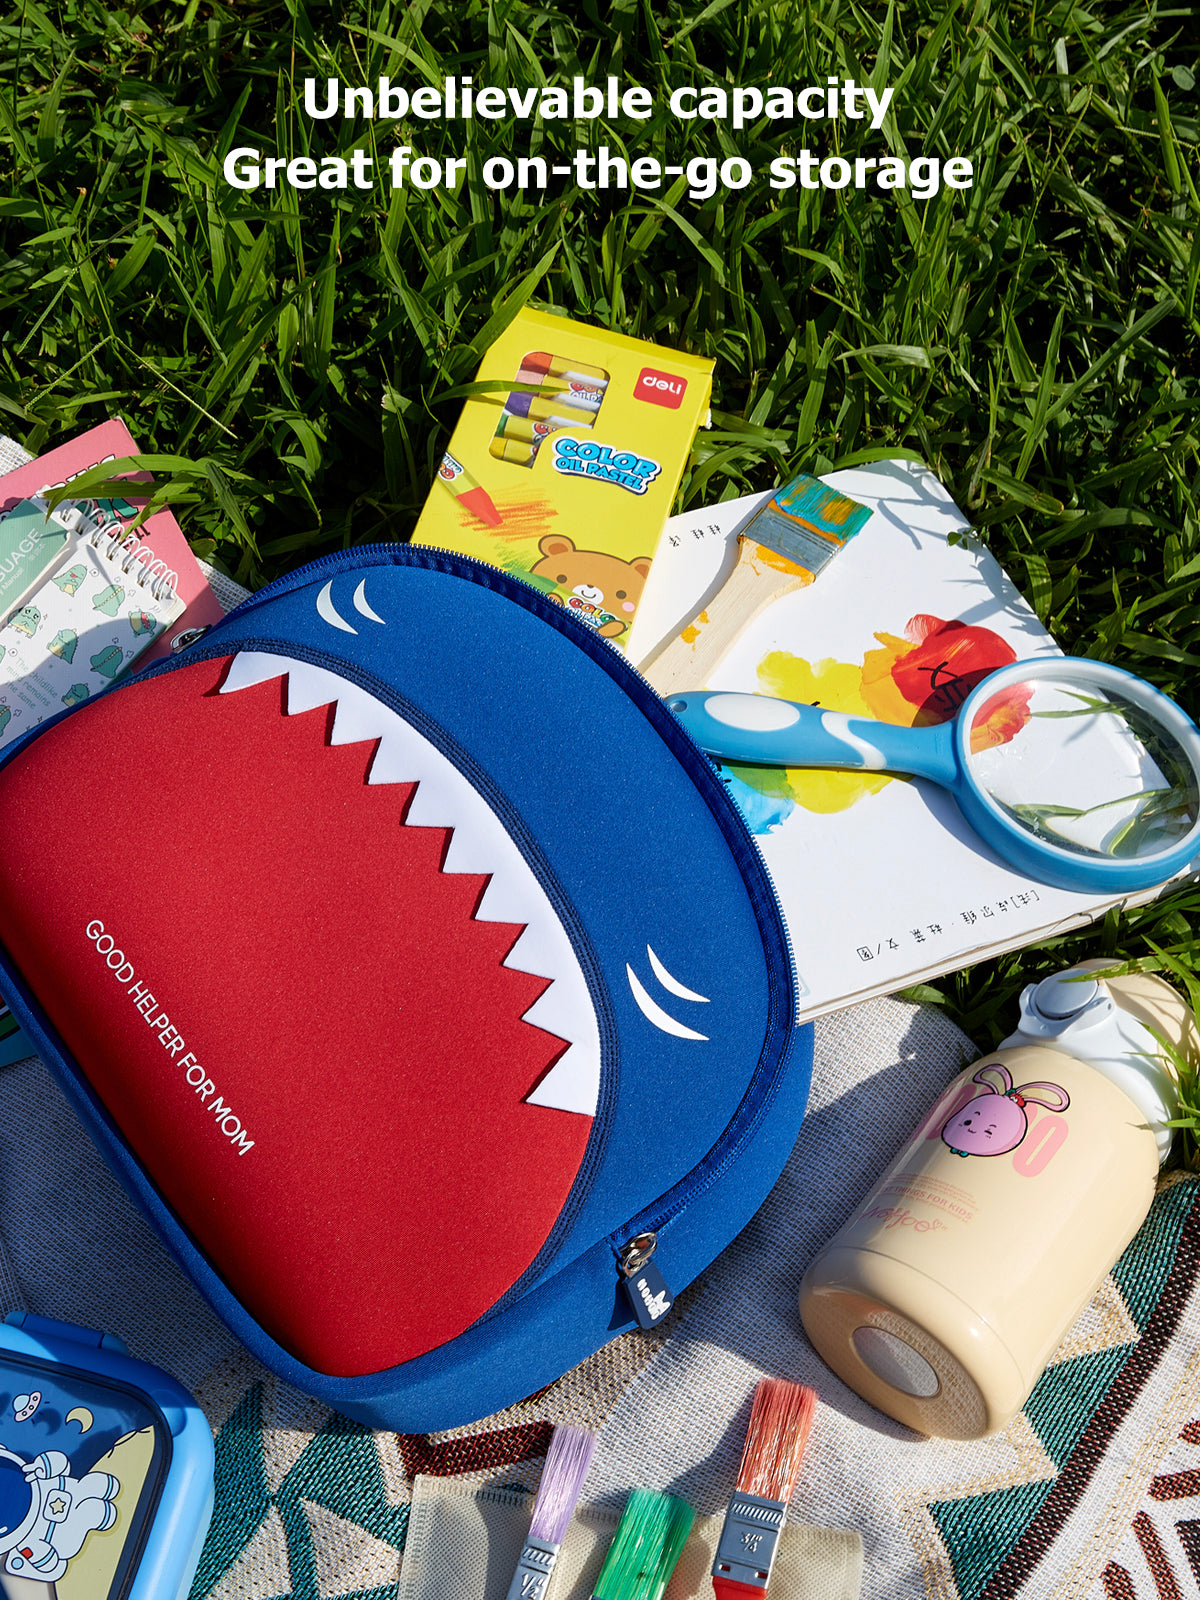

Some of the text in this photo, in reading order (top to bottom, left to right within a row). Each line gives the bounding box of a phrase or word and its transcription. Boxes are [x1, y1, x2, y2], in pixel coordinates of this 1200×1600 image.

[642, 376, 682, 395] deli
[555, 438, 657, 479] COLOR
[556, 456, 643, 491] OIL PASTEL
[86, 919, 256, 1157] GOOD HELPER FOR MOM
[927, 1192, 948, 1206] FOR
[948, 1201, 974, 1221] KIDS
